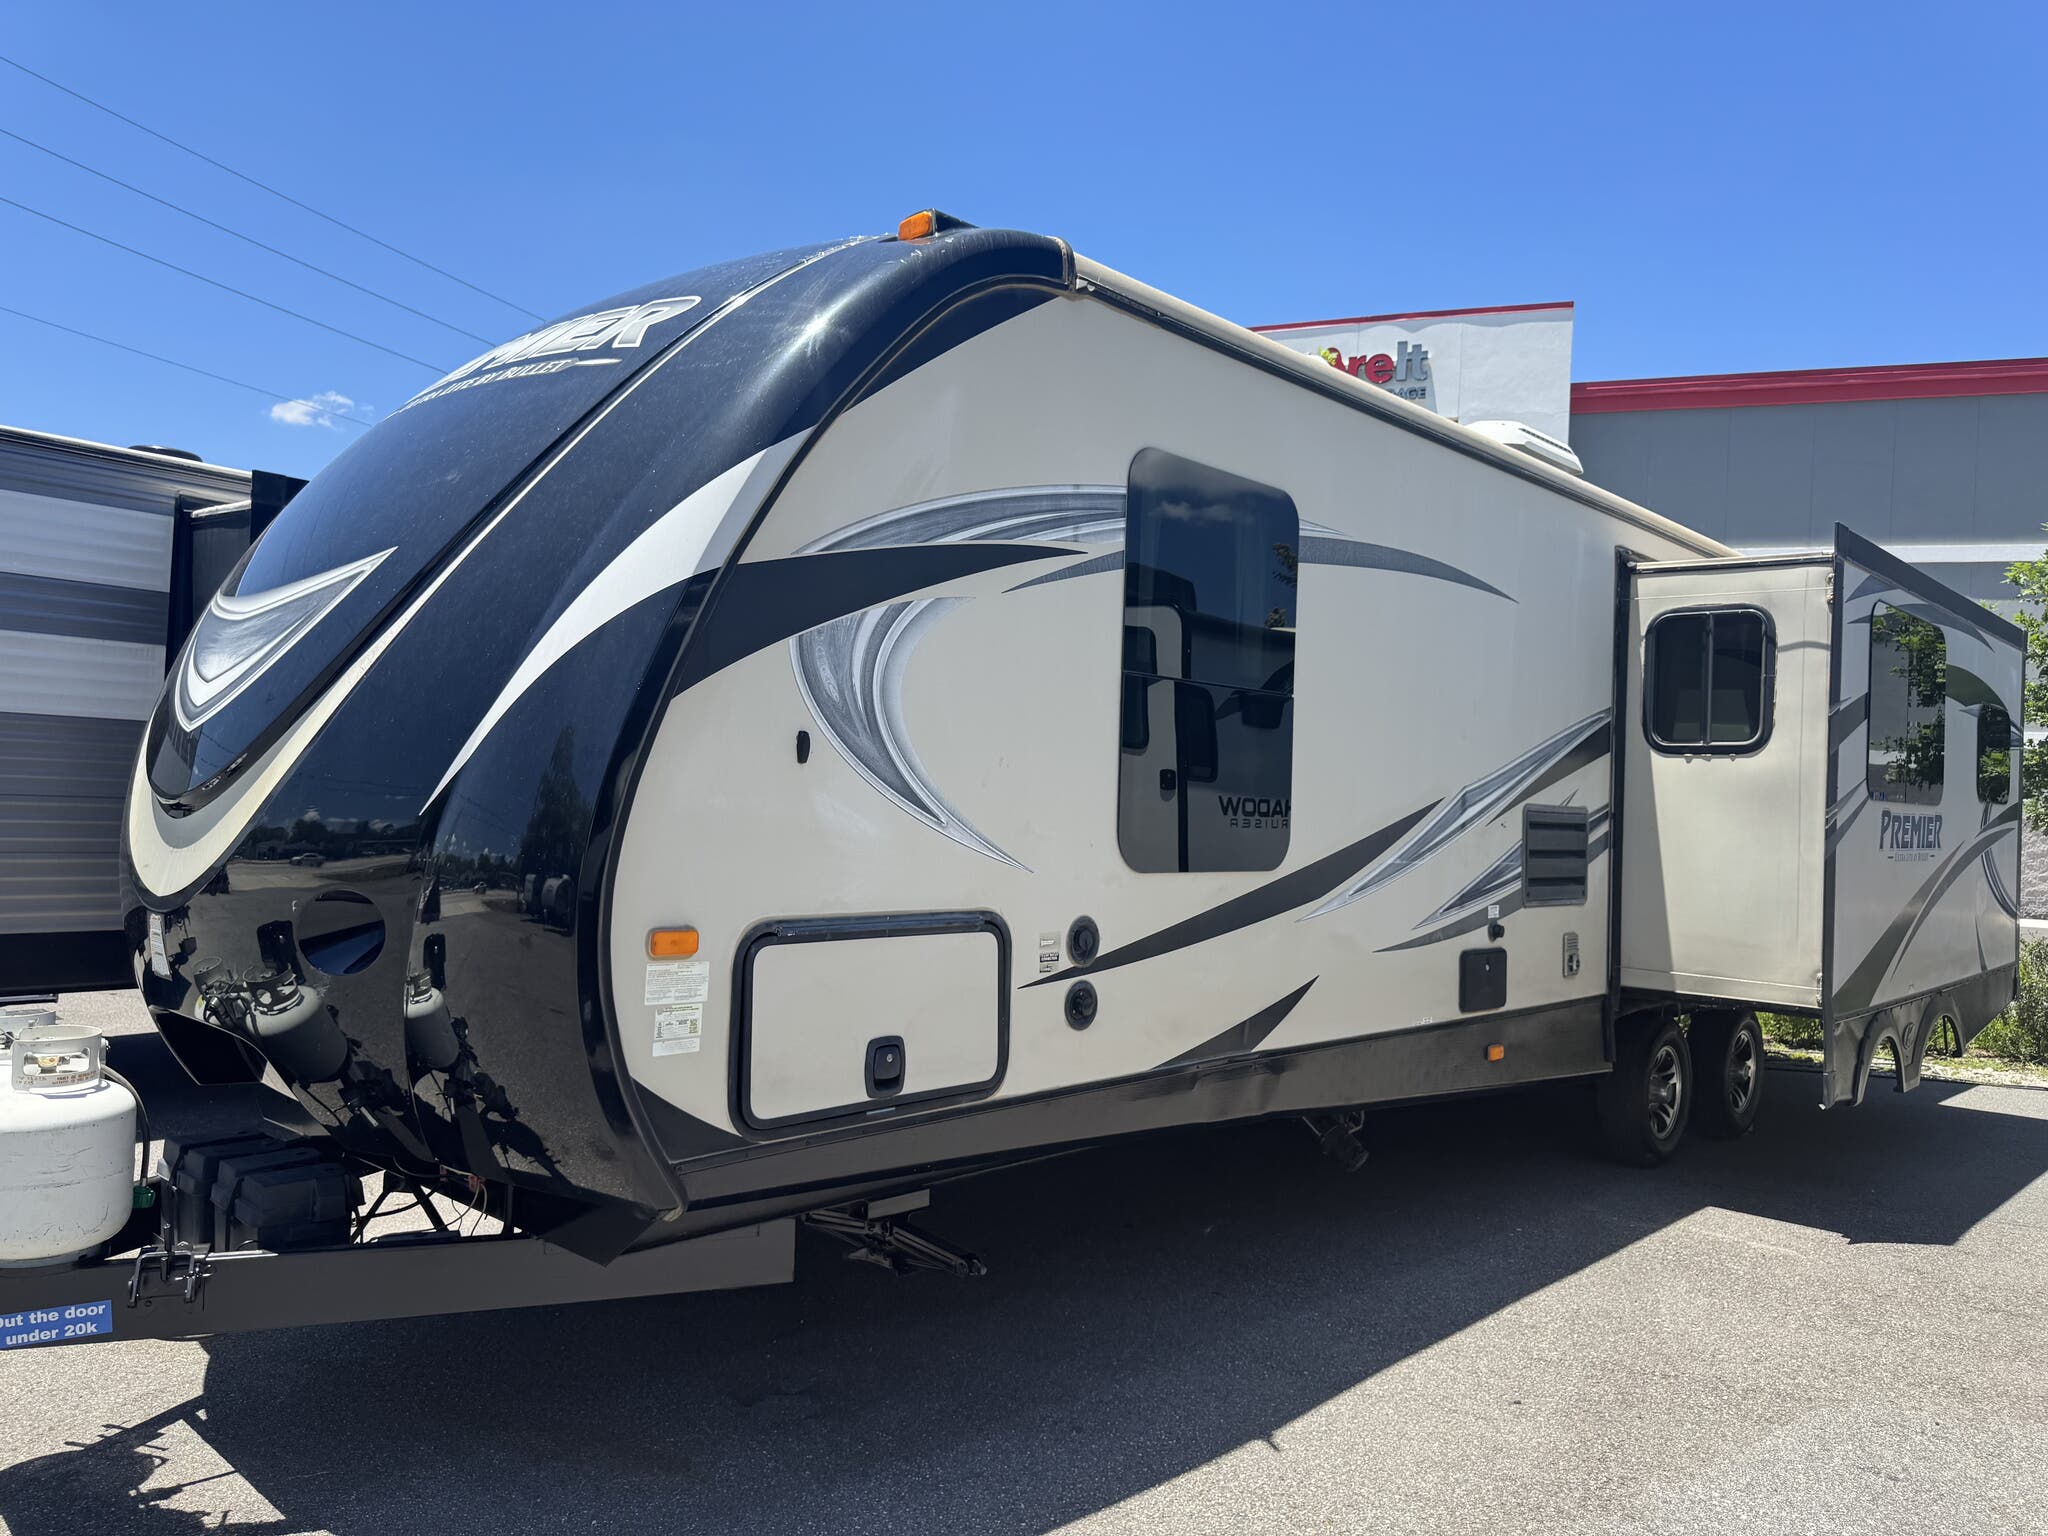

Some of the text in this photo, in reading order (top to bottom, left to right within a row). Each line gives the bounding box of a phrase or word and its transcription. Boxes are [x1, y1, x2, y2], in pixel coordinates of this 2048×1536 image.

[497, 358, 574, 381] BULLET
[1386, 386, 1426, 400] AGE
[1879, 810, 1943, 849] PREMIER
[29, 1311, 59, 1323] the
[64, 1304, 106, 1319] door
[6, 1321, 98, 1345] under 20k
